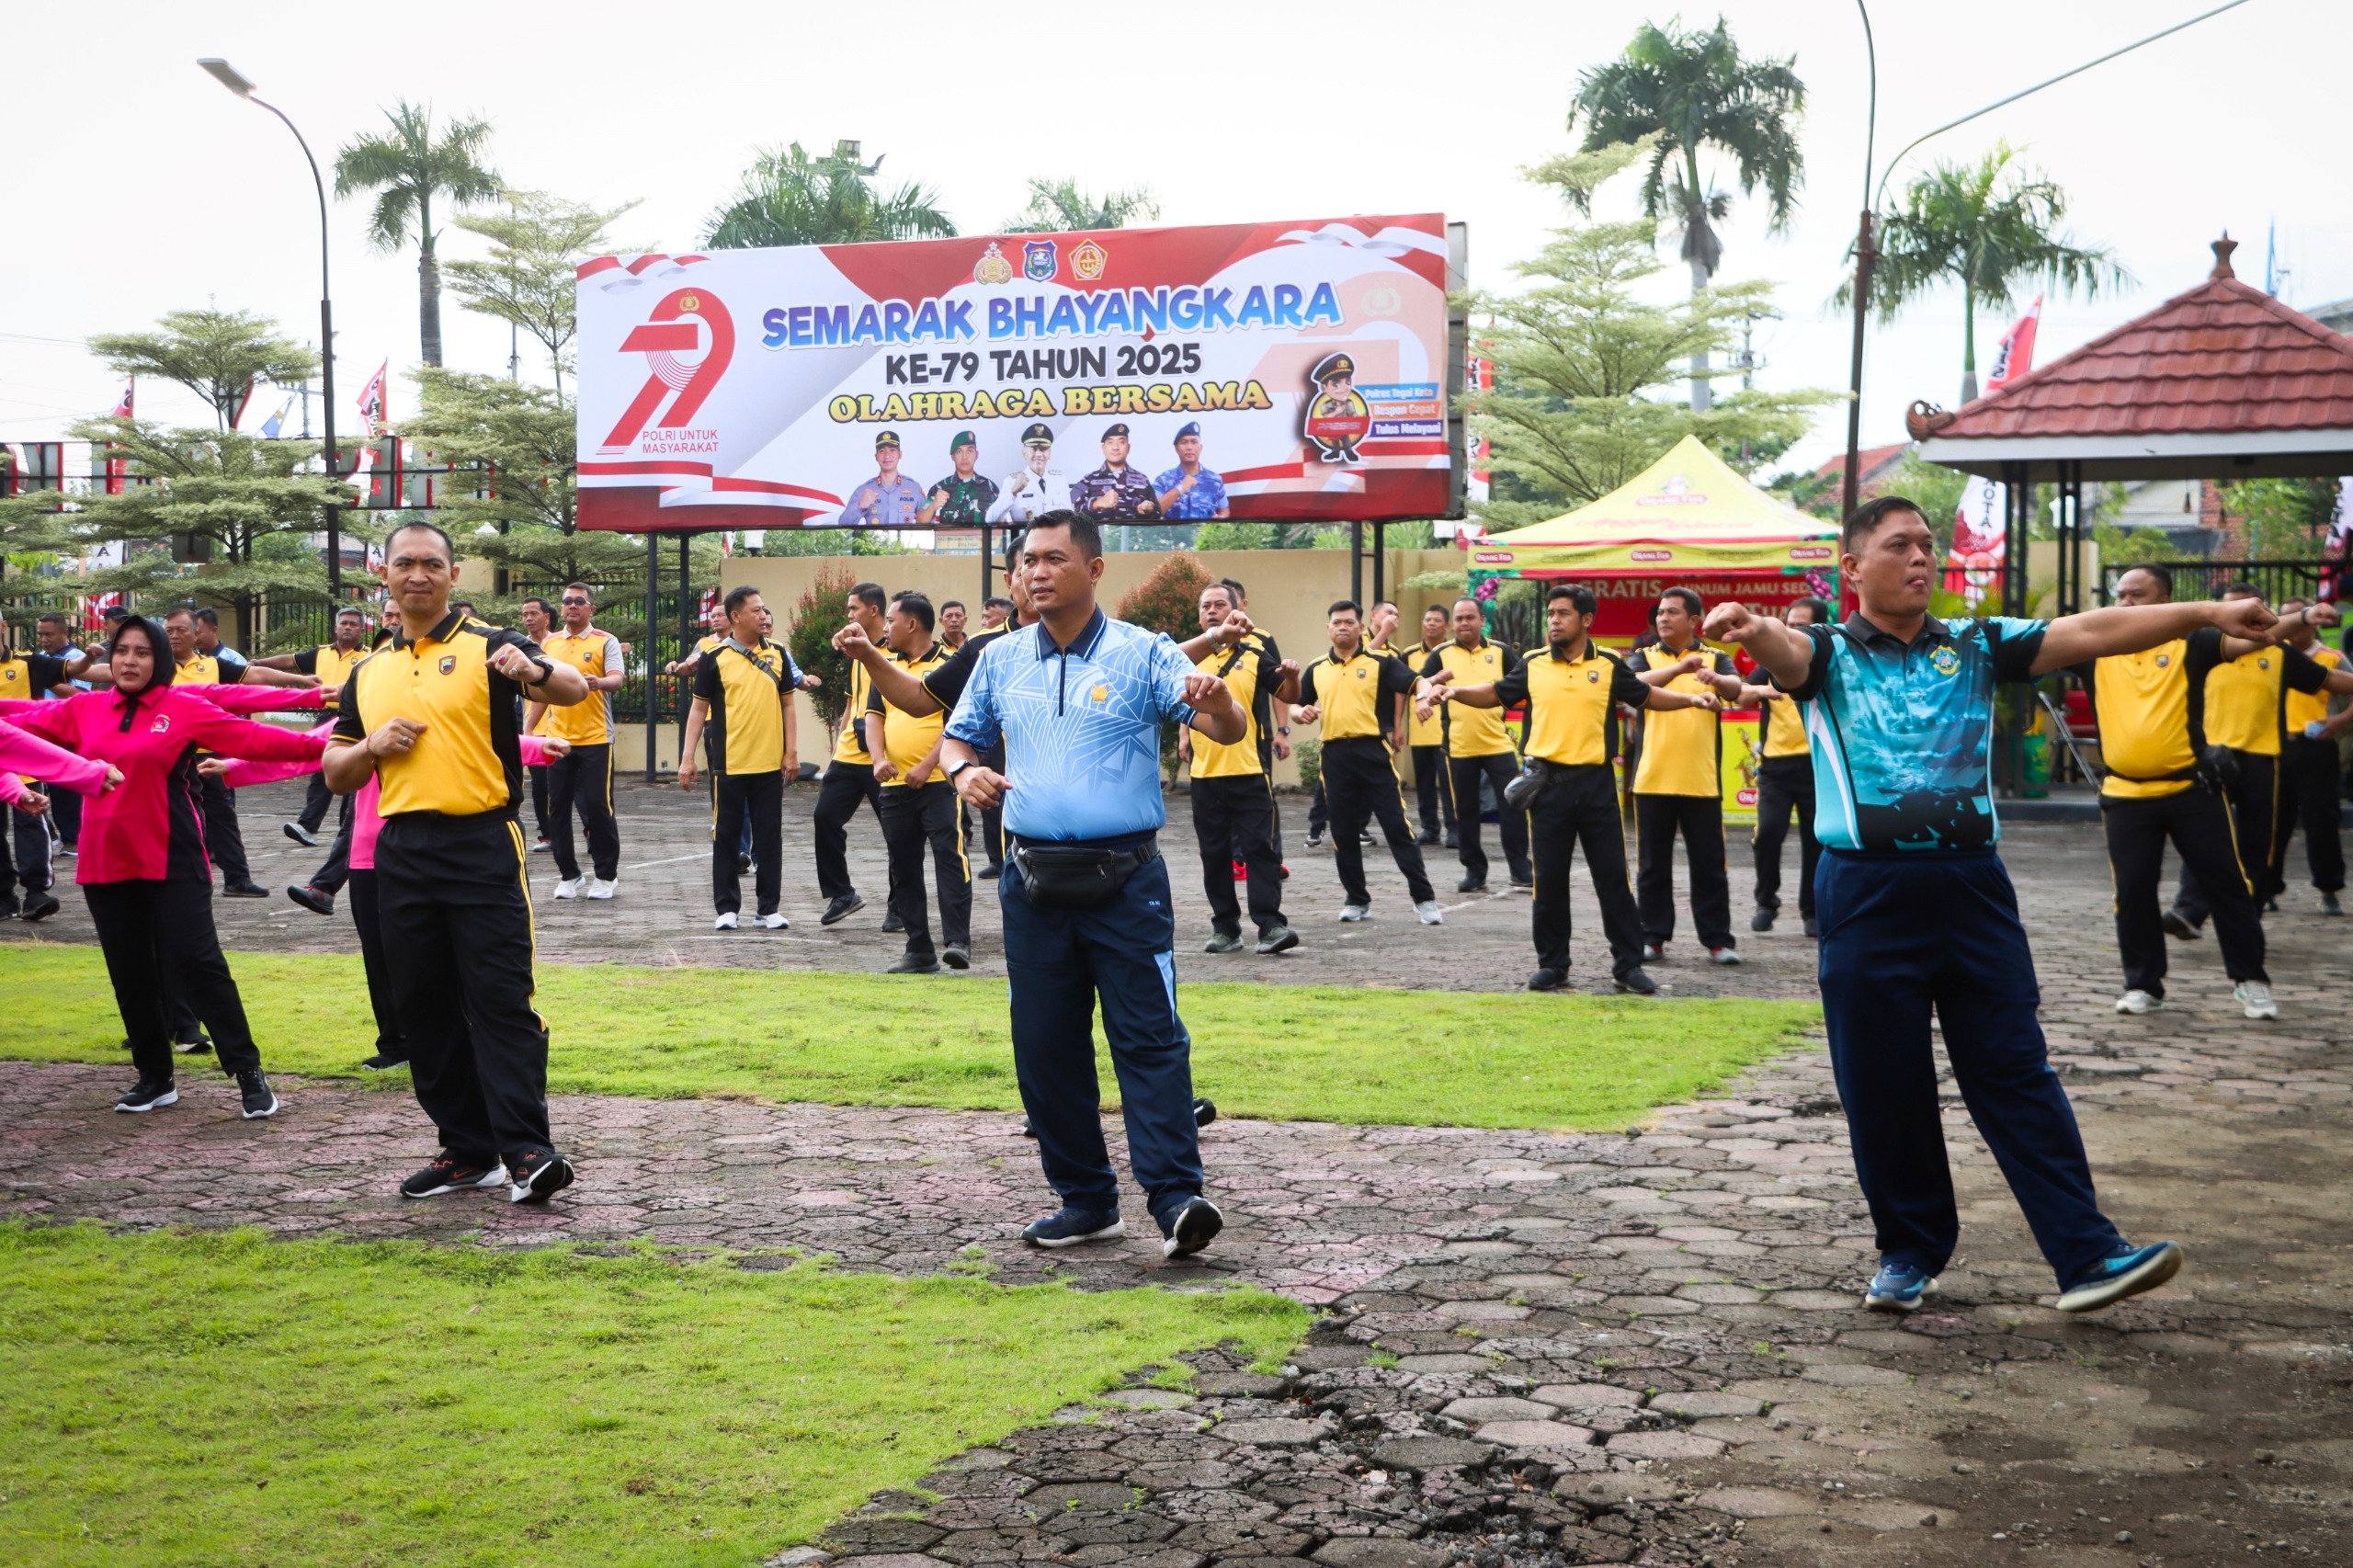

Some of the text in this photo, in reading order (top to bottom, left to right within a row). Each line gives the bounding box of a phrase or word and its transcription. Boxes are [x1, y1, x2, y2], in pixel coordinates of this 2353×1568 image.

[762, 281, 1341, 348] SEMARAK BHAYANGKARA
[885, 343, 1201, 385] KE-79 TAHUN 2025
[1365, 388, 1391, 398] Polres
[1392, 387, 1413, 400] Tegal
[828, 380, 1273, 423] OLAHRAGA BERSAMA
[1374, 403, 1436, 417] Respon Cepat
[642, 429, 719, 441] POLRI UNTUK
[1374, 422, 1442, 436] Tulus Melayani
[642, 441, 720, 454] MASYARAKAT
[1475, 553, 1512, 562] ORANG TUA
[1655, 551, 1670, 560] TUA
[1733, 582, 1779, 596] JAMU
